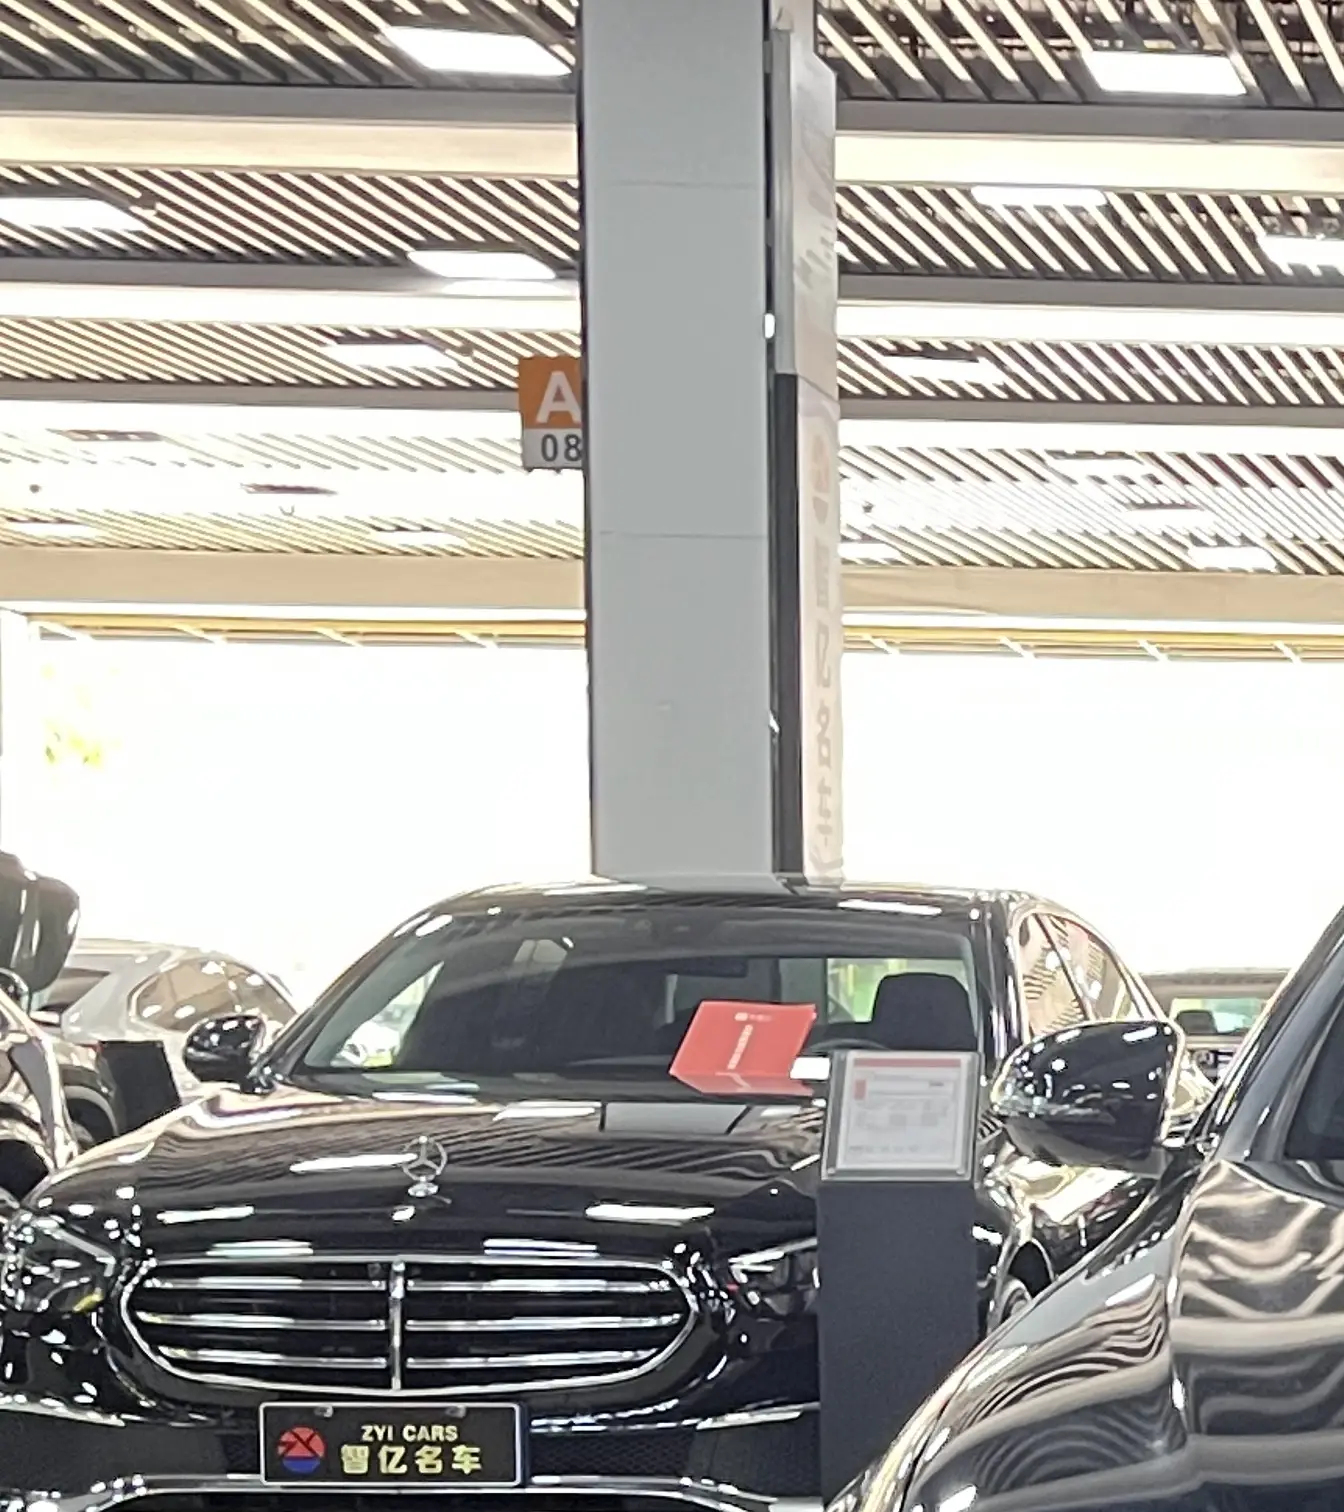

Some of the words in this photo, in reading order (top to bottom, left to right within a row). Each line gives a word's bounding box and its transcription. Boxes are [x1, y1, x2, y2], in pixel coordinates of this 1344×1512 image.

[537, 371, 581, 422] A
[540, 434, 582, 462] 08
[361, 1425, 393, 1441] ZYI
[403, 1425, 458, 1441] CARS
[341, 1444, 482, 1475] 智亿名车
